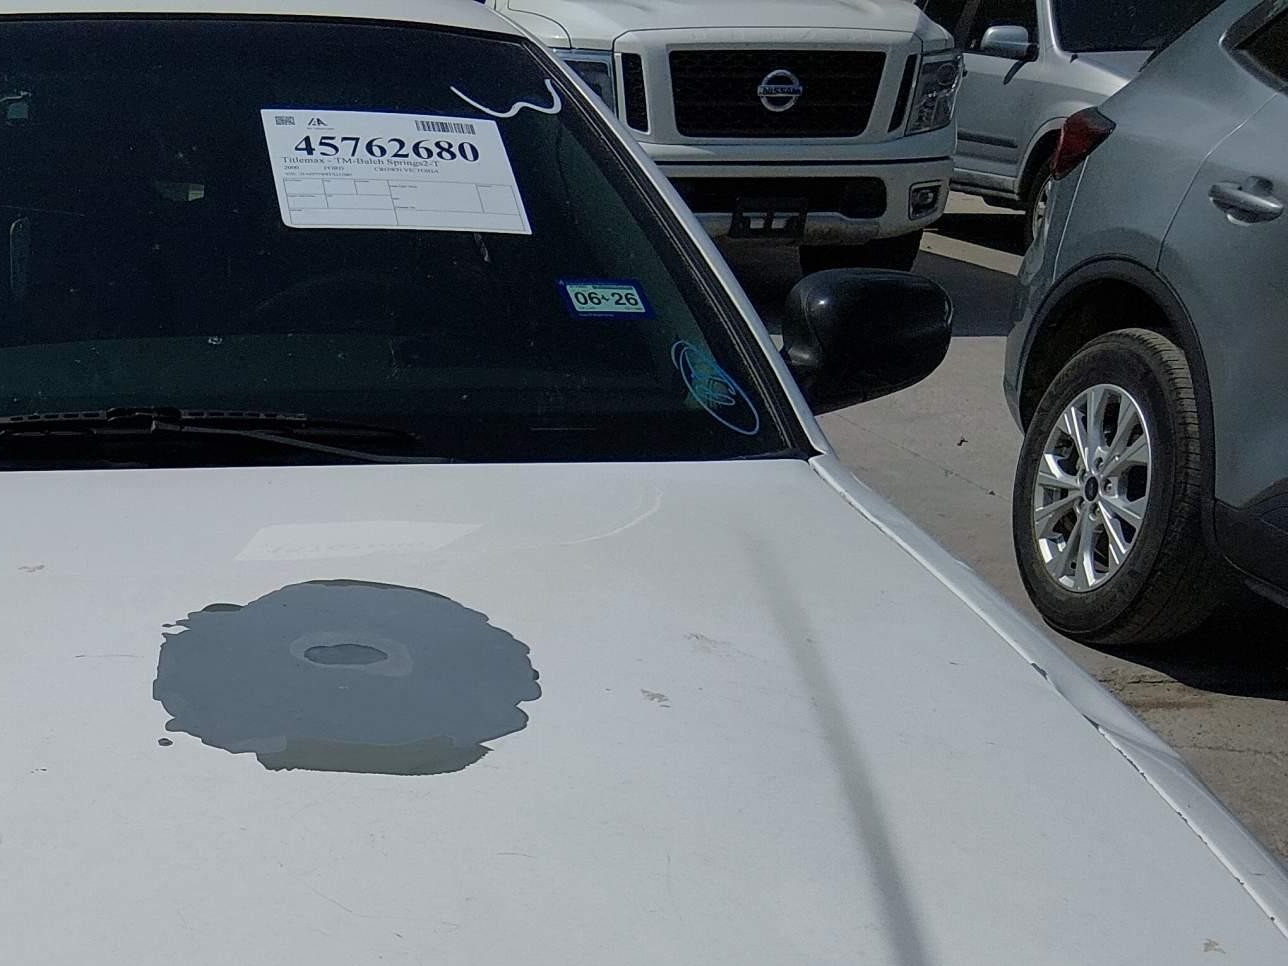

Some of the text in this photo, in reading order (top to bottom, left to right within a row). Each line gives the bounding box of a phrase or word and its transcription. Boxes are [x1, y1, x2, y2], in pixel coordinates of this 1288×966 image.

[760, 86, 801, 95] NISSAN
[294, 135, 480, 162] 45762680
[280, 156, 324, 164] Titlemax
[574, 292, 639, 306] 06 26
